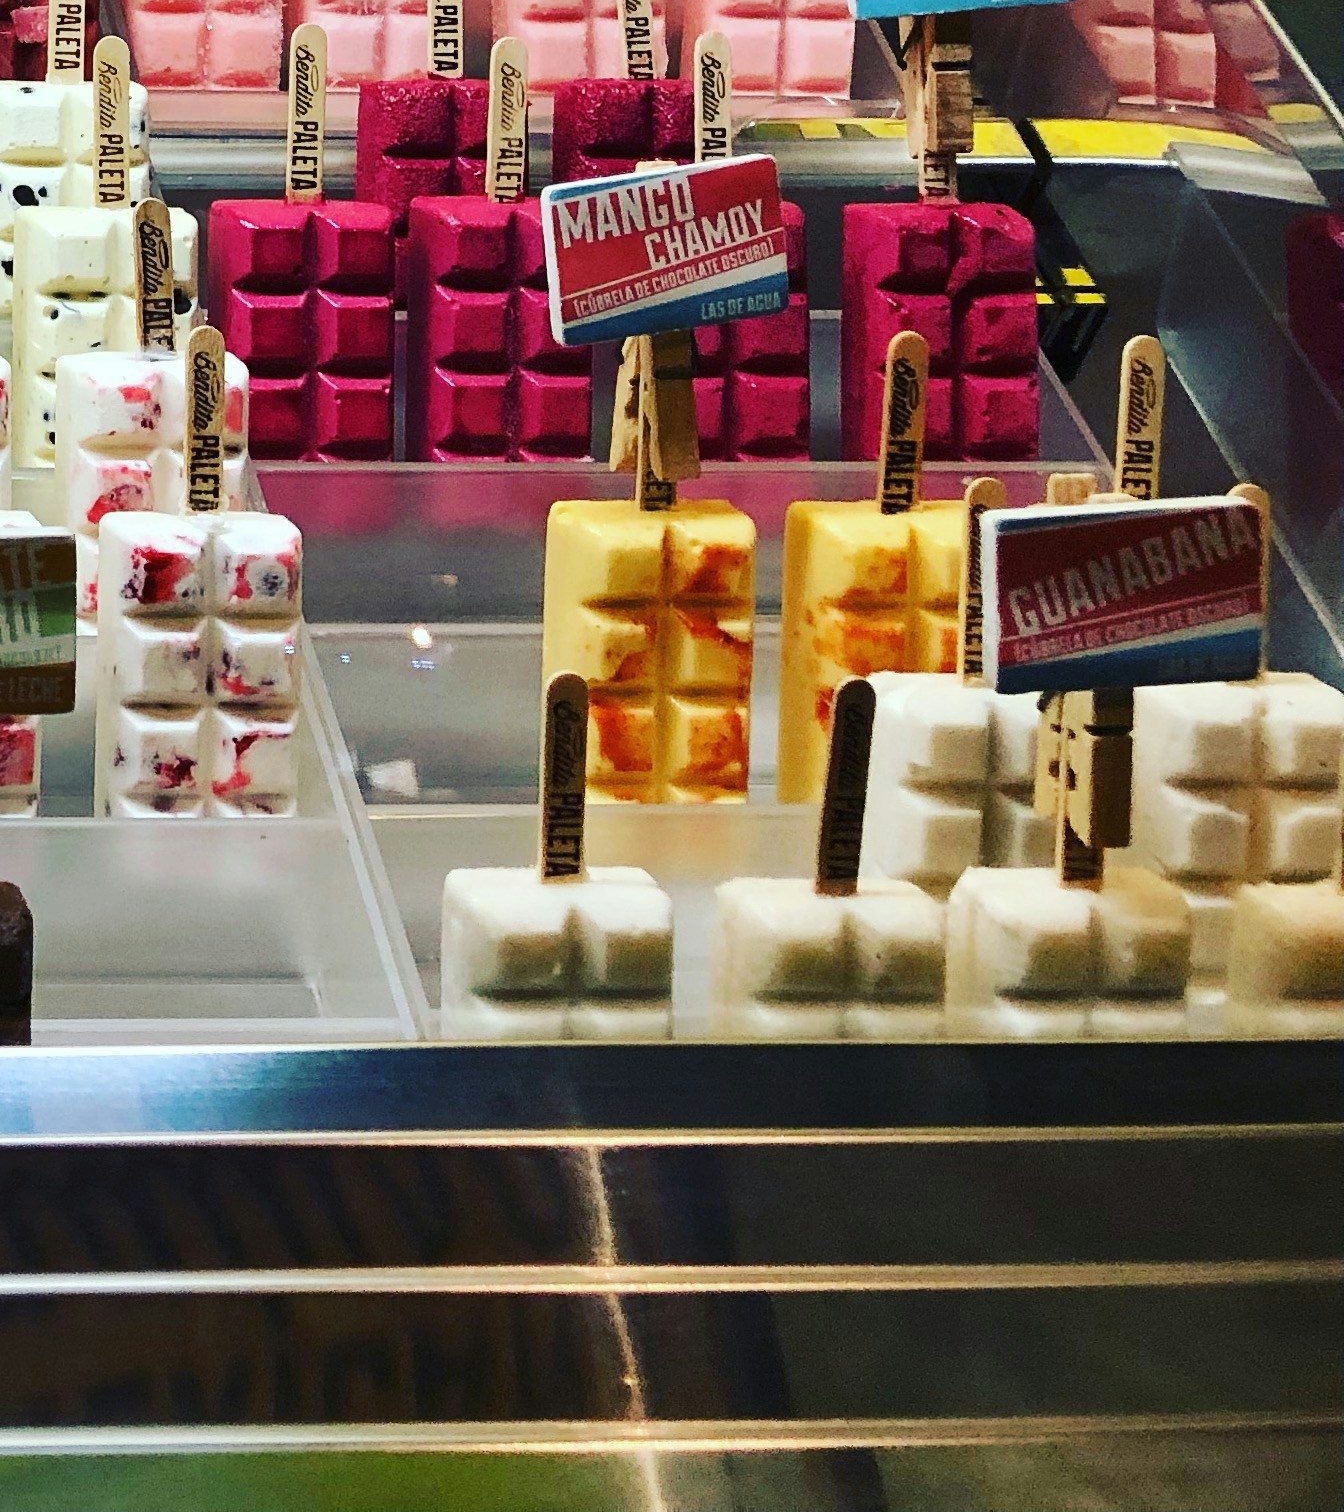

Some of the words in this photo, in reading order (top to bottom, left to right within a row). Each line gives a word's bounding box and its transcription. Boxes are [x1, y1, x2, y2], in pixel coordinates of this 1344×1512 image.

[54, 4, 81, 70] PALETA
[434, 5, 459, 70] PALETA
[291, 120, 318, 191] PALETA
[557, 174, 695, 249] MANGO
[644, 199, 764, 271] CHAMOY
[1009, 505, 1258, 636] GUANABANA
[545, 785, 585, 878] PALETA
